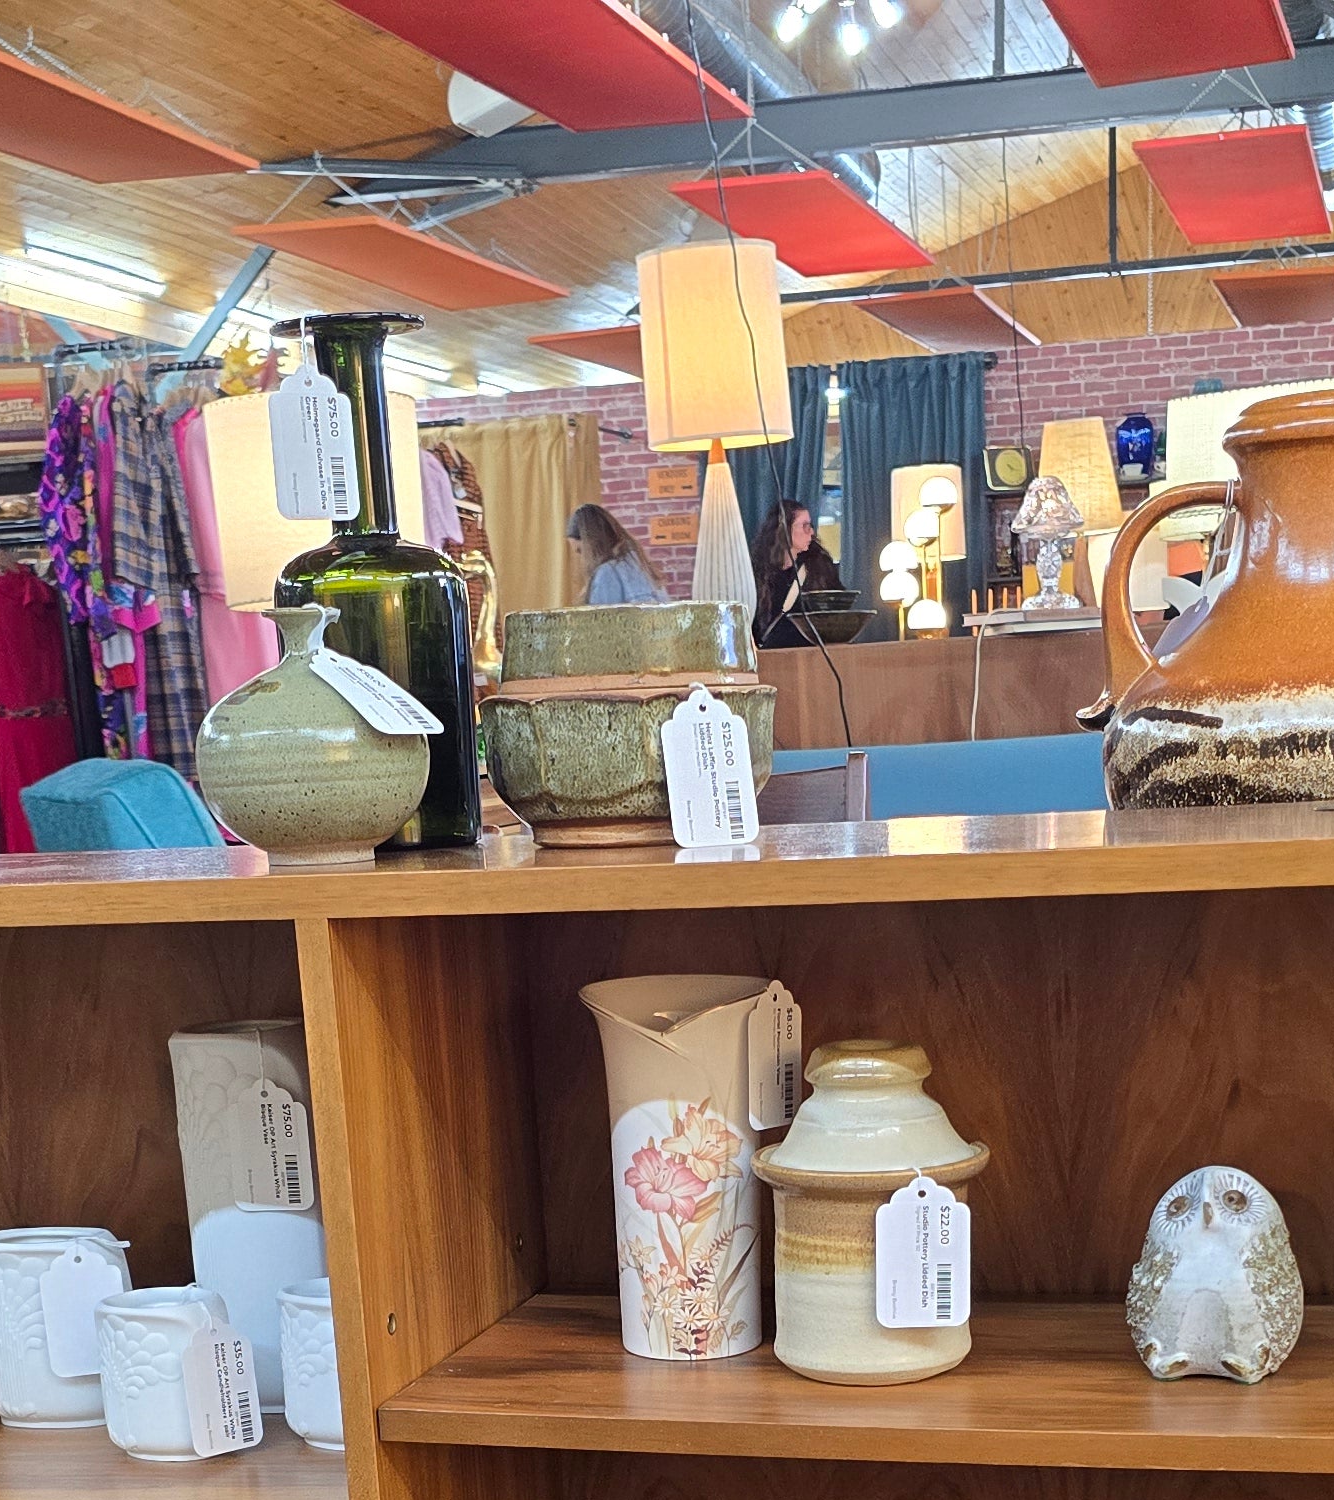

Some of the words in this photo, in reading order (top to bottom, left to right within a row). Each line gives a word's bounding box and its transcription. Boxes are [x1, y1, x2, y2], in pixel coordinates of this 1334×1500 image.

[304, 396, 312, 421] Green
[326, 396, 340, 437] $75.00
[310, 396, 322, 446] Holmegaard
[319, 490, 328, 510] Olive
[697, 722, 707, 750] Lidded
[704, 722, 713, 745] Heinz
[720, 720, 735, 766] $125.00
[701, 751, 709, 770] Dish
[709, 770, 719, 797] Studio
[711, 798, 722, 829] Pottery
[258, 1103, 267, 1127] Bisque
[280, 1103, 294, 1138] $75.00
[269, 1137, 277, 1149] Art
[273, 1178, 281, 1198] White
[921, 1205, 929, 1231] Studio
[939, 1205, 951, 1245] $22.00
[920, 1232, 928, 1261] Pottery
[212, 1342, 222, 1368] Bisque
[232, 1339, 245, 1375] $35.00
[216, 1368, 228, 1419] Candleholders
[219, 1341, 227, 1365] Kaiser
[228, 1418, 236, 1440] White
